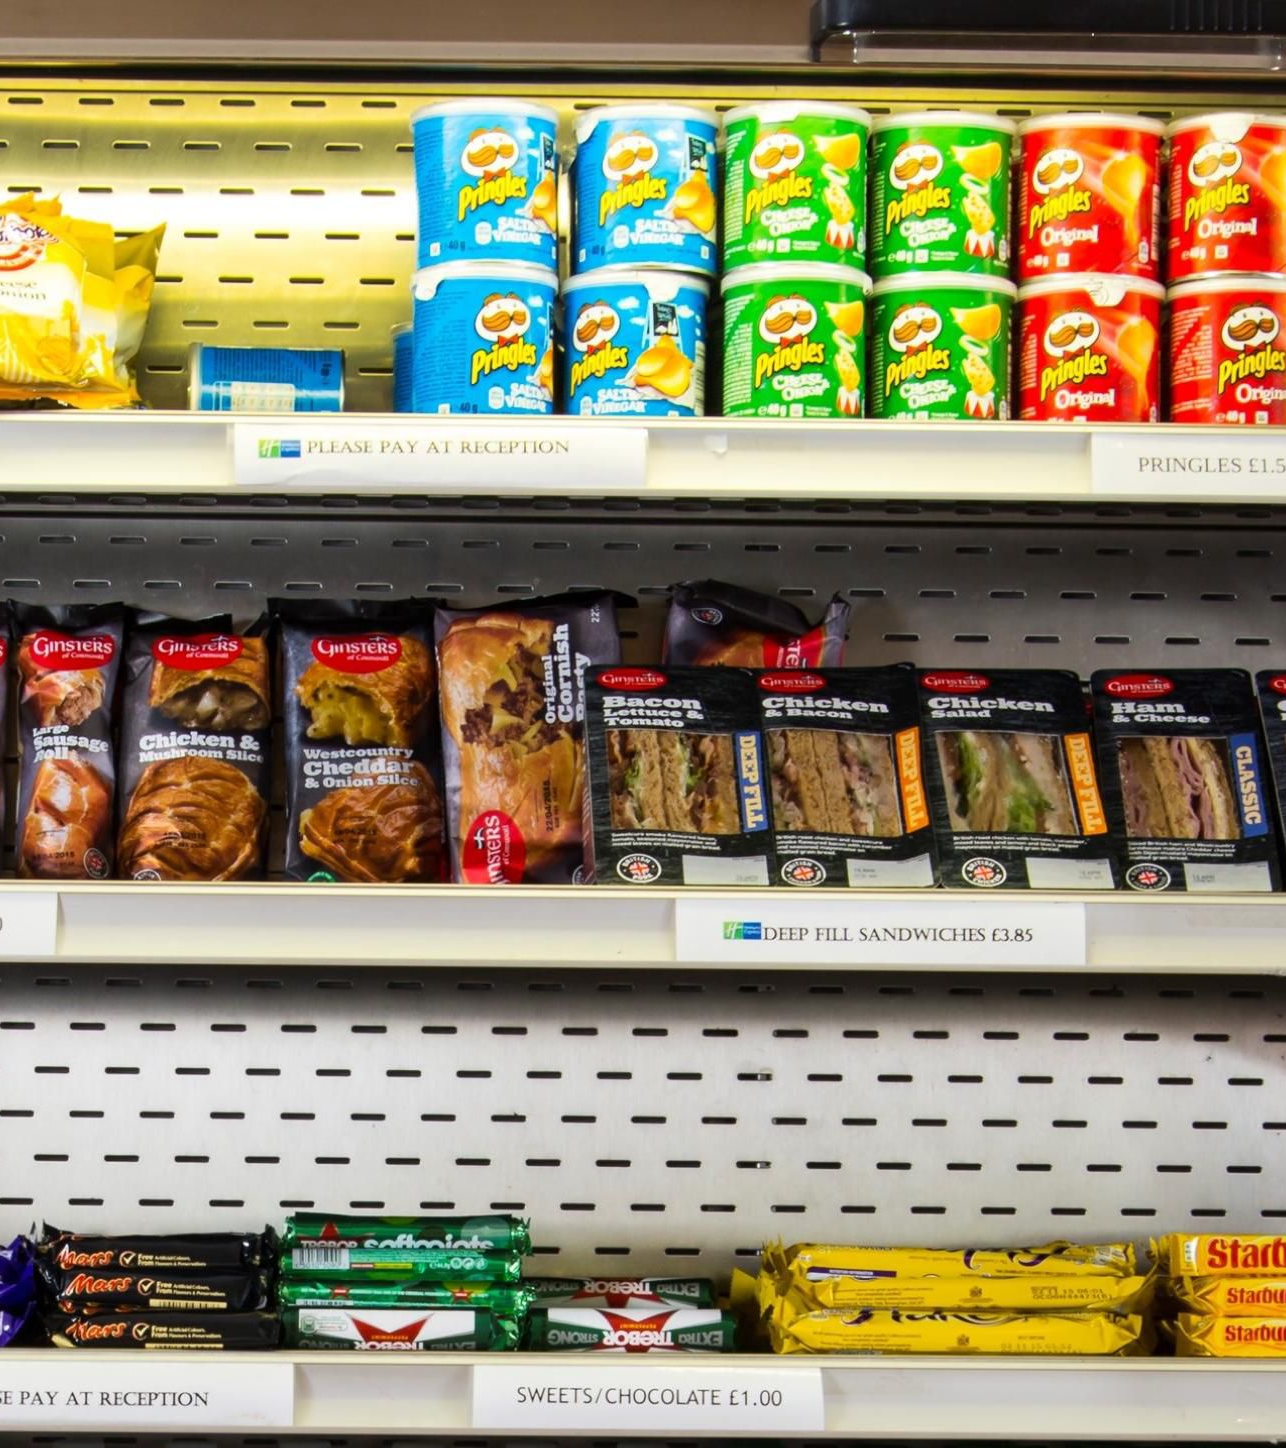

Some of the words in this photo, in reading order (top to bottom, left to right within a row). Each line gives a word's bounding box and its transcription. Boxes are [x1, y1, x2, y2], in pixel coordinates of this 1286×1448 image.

[457, 171, 528, 222] Pringles
[599, 171, 668, 227] Pringles
[745, 171, 813, 225] Pringles
[1183, 177, 1251, 232] Pringles
[885, 180, 951, 235] Pringles
[1028, 181, 1092, 237] Pringles
[1040, 220, 1099, 248] Original
[1197, 216, 1258, 240] Original
[470, 337, 537, 385] Pringles
[570, 341, 629, 397] Pringles
[754, 337, 826, 389] Pringles
[885, 344, 951, 397] Pringles
[1217, 345, 1286, 394] Pringles
[1040, 348, 1109, 402] Pringles
[1054, 387, 1116, 409] Original
[308, 441, 373, 454] PLEASE
[381, 441, 419, 454] PAY
[427, 441, 451, 454] AT
[460, 441, 570, 454] RECEPTION
[1138, 456, 1242, 473] PRINGLES
[553, 623, 574, 723] Cornish
[542, 654, 555, 724] Original
[603, 696, 702, 711] Bacon
[762, 696, 890, 714] Chicken
[765, 709, 783, 719] &
[785, 708, 853, 720] Bacon
[928, 697, 1055, 714] Chicken
[931, 709, 992, 719] Salad
[1111, 702, 1185, 714] Ham
[603, 708, 684, 720] Lettuce
[688, 710, 704, 721] &
[605, 717, 685, 728] Tomato
[1113, 713, 1130, 724] &
[1133, 713, 1211, 724] Cheese
[33, 735, 109, 753] Sausage
[139, 732, 235, 751] Chicken
[239, 735, 261, 750] &
[139, 748, 224, 763] Mushroom
[225, 750, 263, 763] Slice
[303, 747, 414, 761] Westcountry
[739, 735, 759, 784] DEEP
[303, 759, 414, 777] Cheddar
[304, 776, 319, 789] &
[322, 776, 374, 788] Onion
[376, 774, 419, 787] Slice
[1235, 745, 1263, 825] CLASSIC
[744, 784, 763, 829] FILL
[763, 926, 810, 942] DEEP
[815, 927, 854, 943] FILL
[859, 927, 986, 943] SANDWICHES
[991, 927, 1034, 943] £3.85
[66, 1273, 133, 1296] Mars
[65, 1319, 128, 1340] Mars
[19, 1390, 59, 1406] PAY
[65, 1391, 93, 1406] AT
[99, 1391, 209, 1407] RECEPTION
[517, 1386, 722, 1406] SWEETS/CHOCOLATE
[729, 1389, 783, 1407] £1.00
